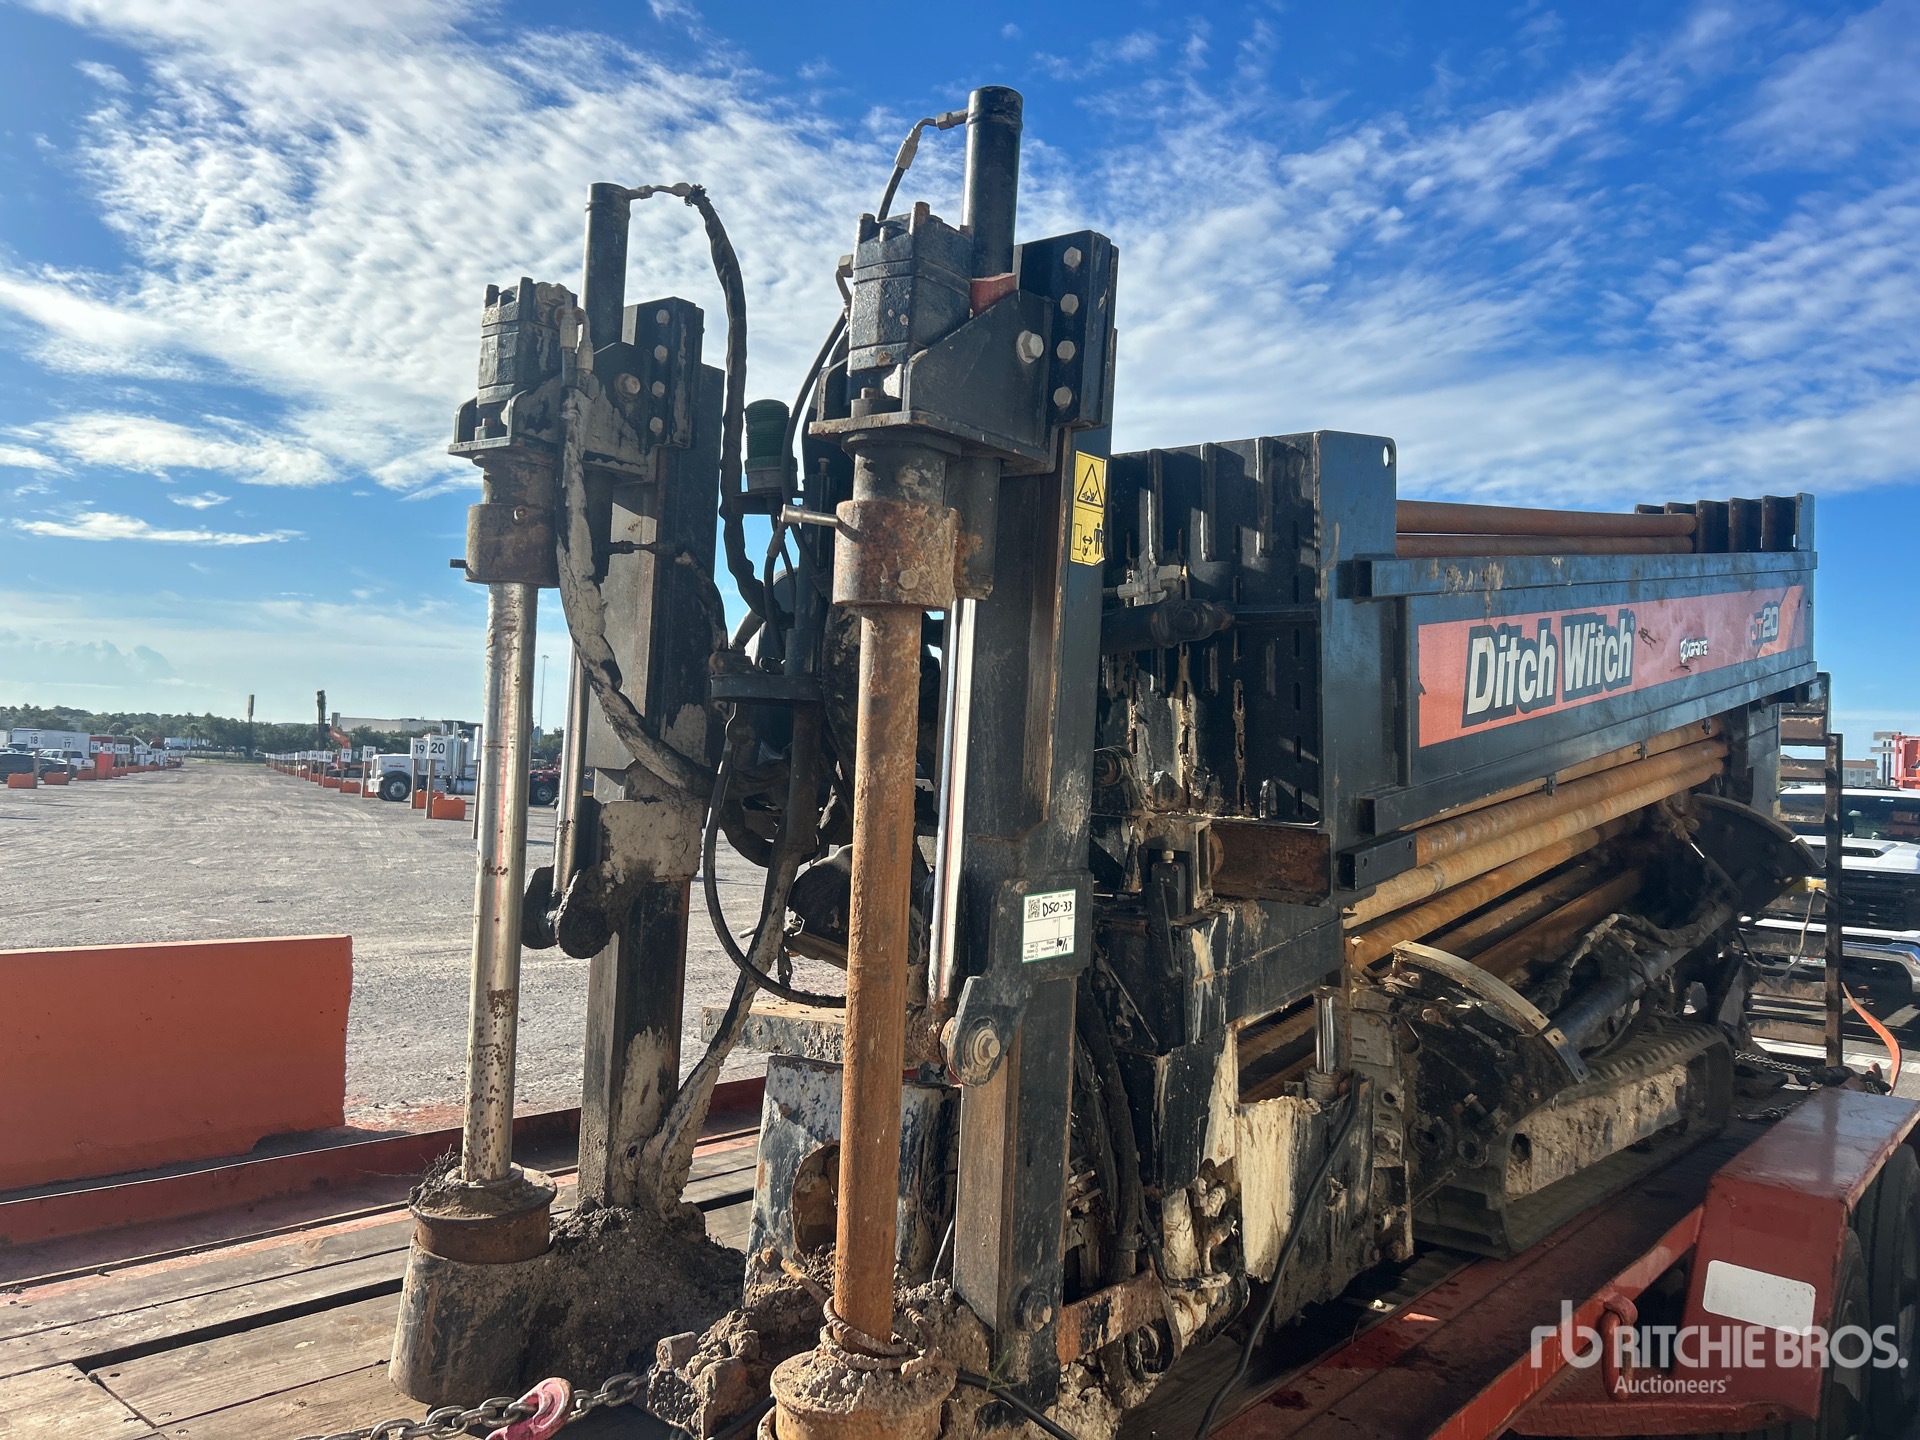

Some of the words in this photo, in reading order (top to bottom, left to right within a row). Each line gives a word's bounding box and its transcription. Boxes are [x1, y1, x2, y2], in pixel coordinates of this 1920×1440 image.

[1466, 628, 1556, 715] Ditch
[30, 736, 38, 744] 18
[415, 744, 425, 754] 19
[430, 742, 445, 754] 20
